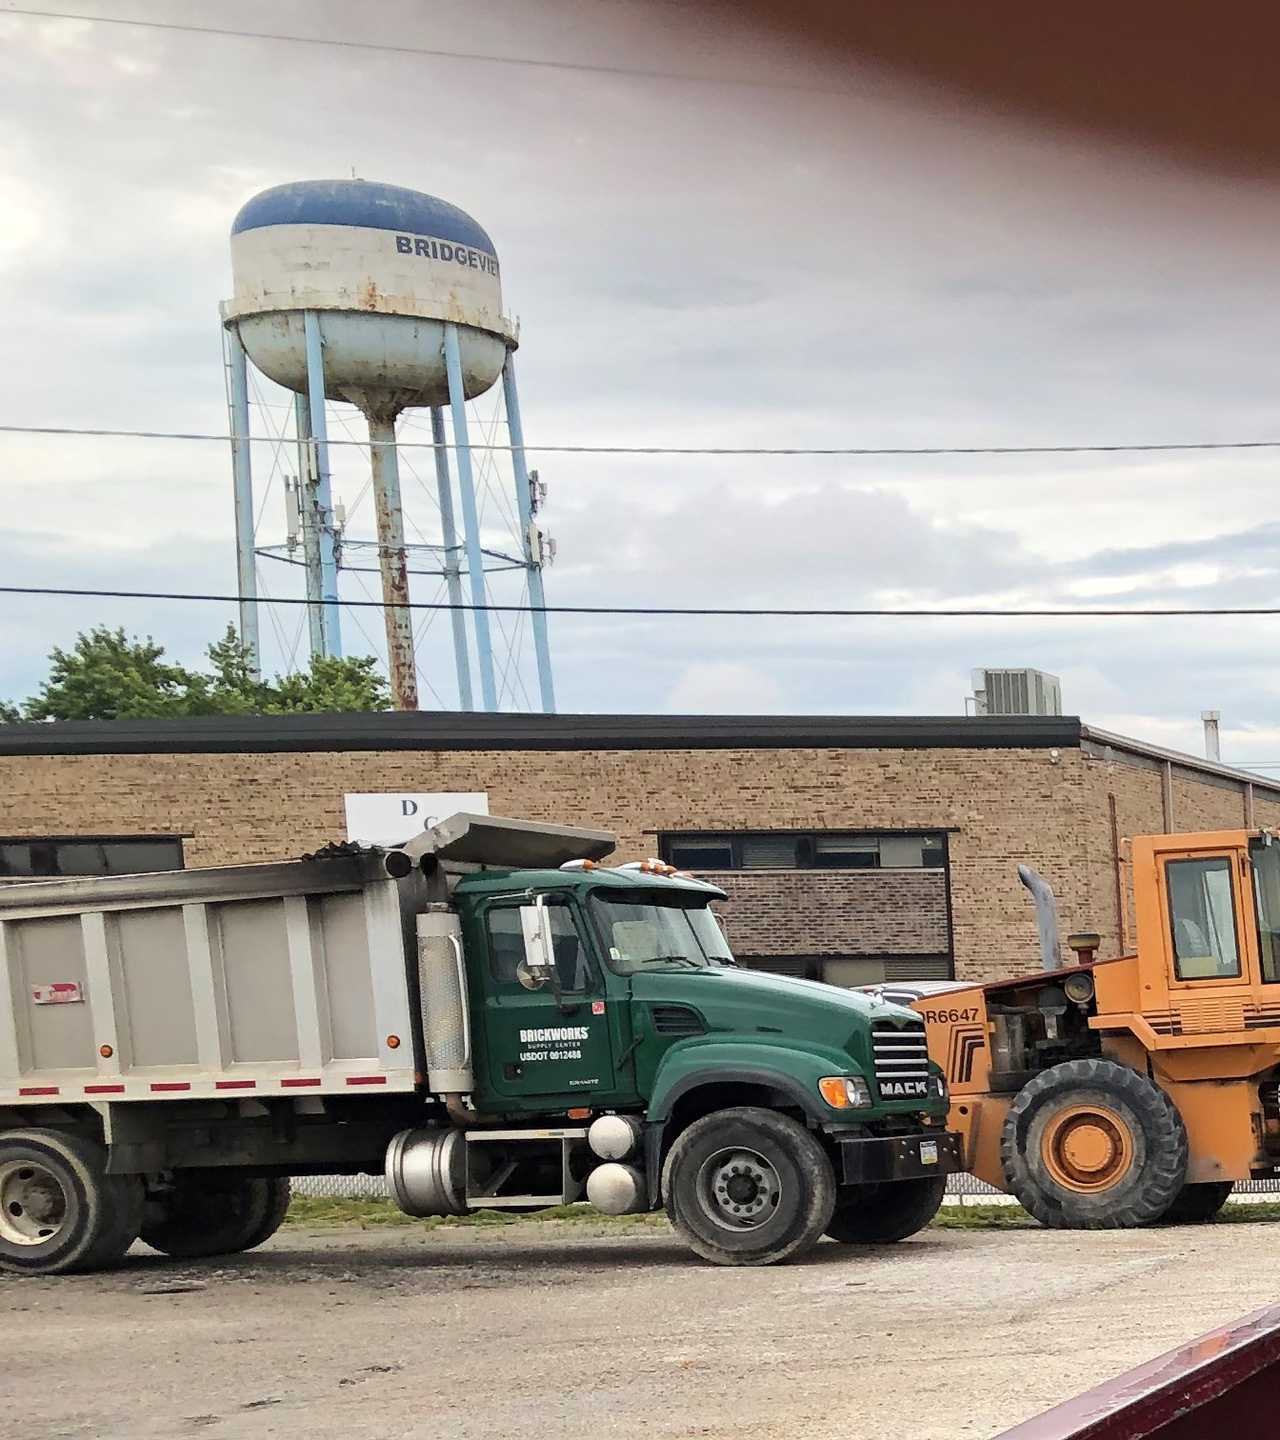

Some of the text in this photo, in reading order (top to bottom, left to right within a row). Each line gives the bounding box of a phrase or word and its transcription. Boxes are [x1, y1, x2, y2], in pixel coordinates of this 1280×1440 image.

[395, 235, 500, 278] BRIDGEVIE
[401, 800, 418, 816] D
[519, 1026, 589, 1042] BRICKWORKS
[520, 1050, 548, 1061] USDOT
[879, 1081, 928, 1095] MACK
